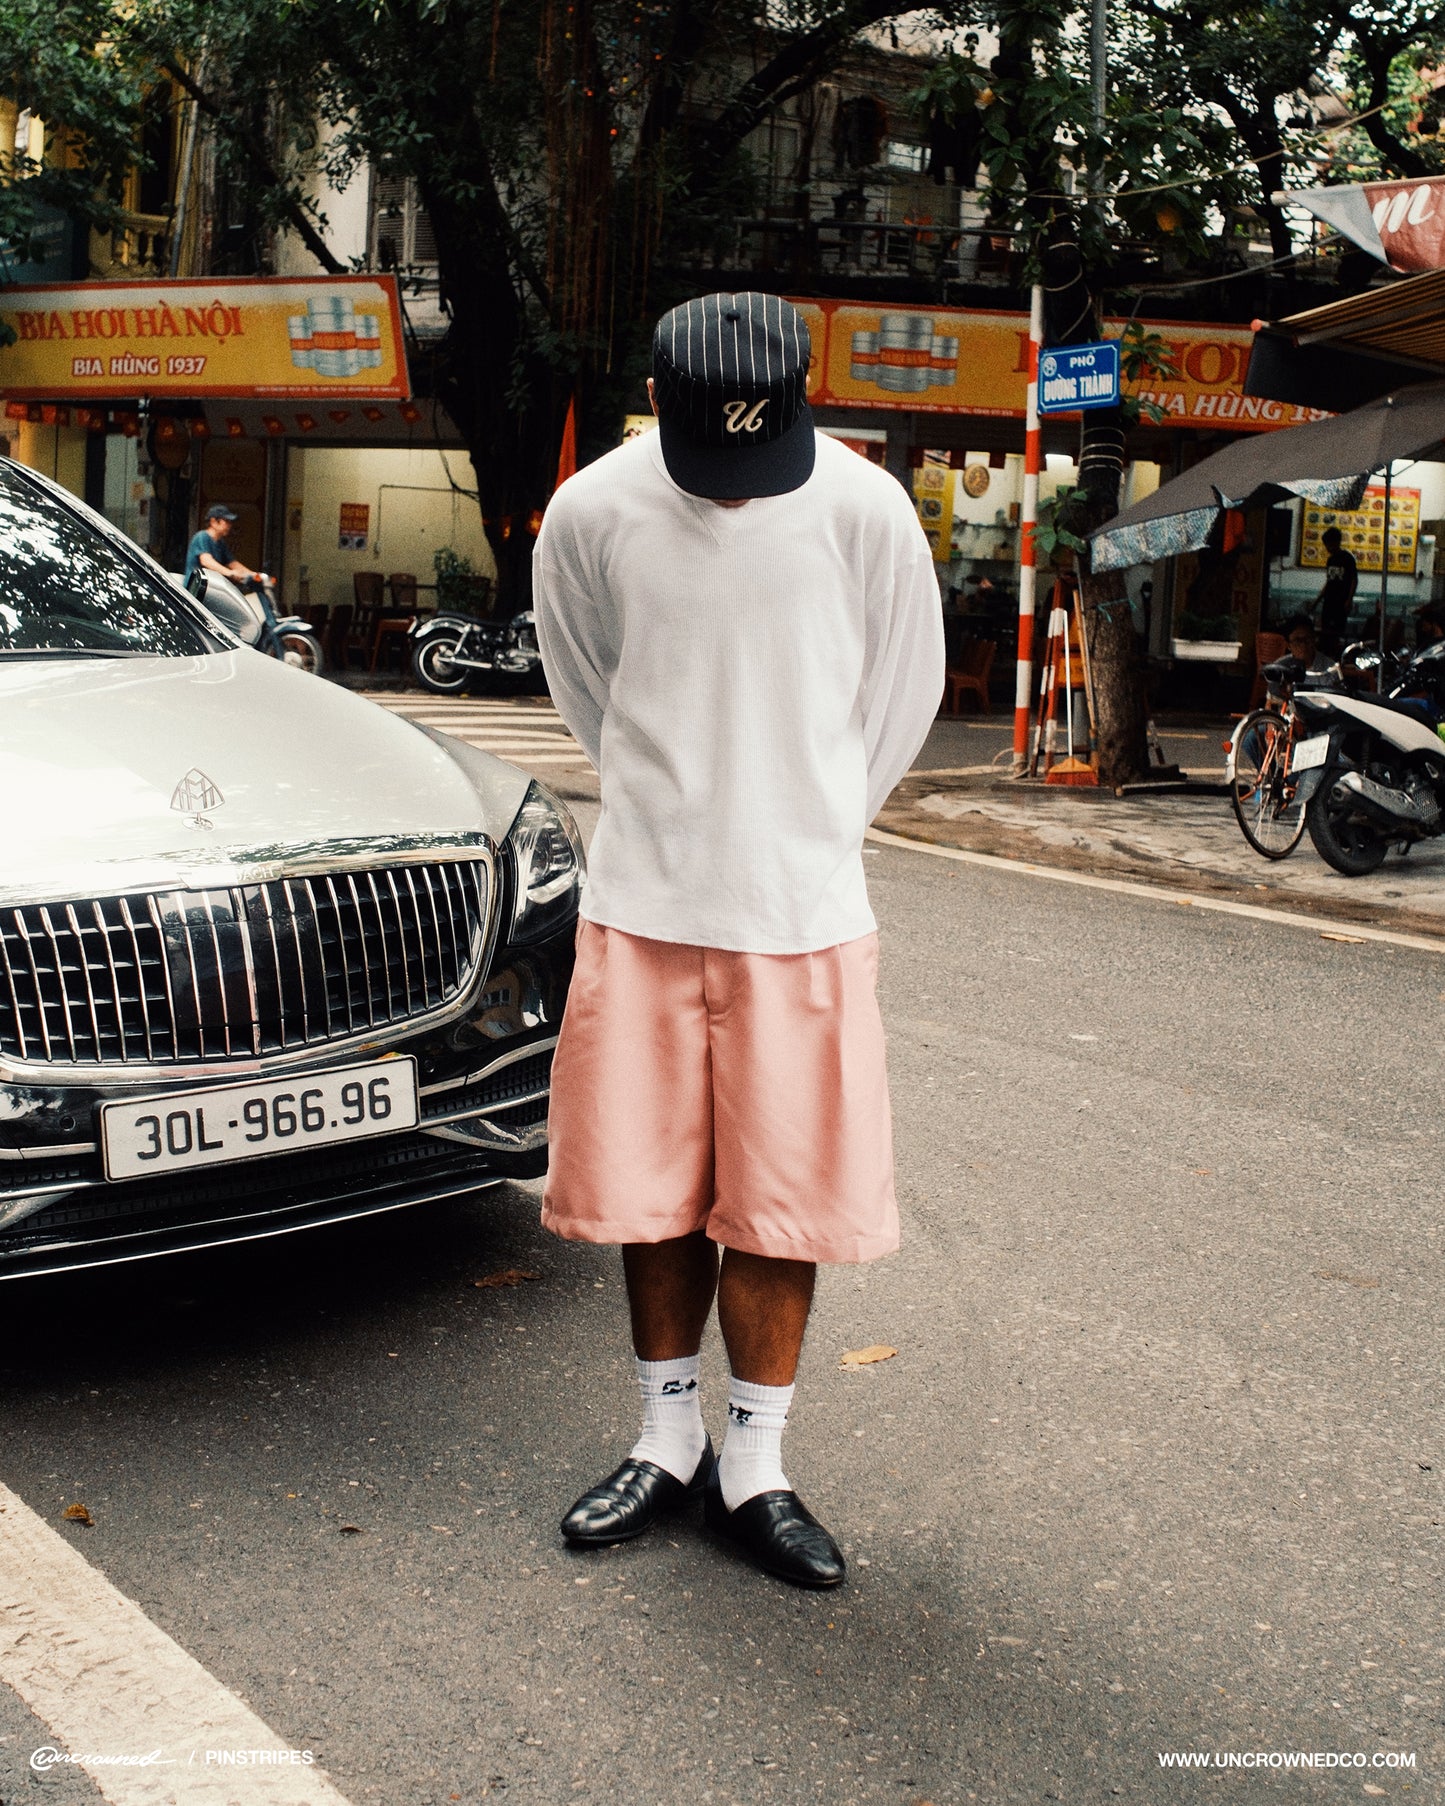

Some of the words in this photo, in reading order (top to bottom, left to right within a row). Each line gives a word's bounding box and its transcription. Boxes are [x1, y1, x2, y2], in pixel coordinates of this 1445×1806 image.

[15, 310, 68, 340] BIA
[131, 299, 181, 338] HÀ
[181, 299, 245, 345] NỘI
[73, 358, 102, 376] BIA
[110, 352, 159, 375] HÙNG
[167, 357, 206, 375] 1937
[1080, 370, 1113, 397] THÀNH
[1193, 389, 1282, 421] HÙNG
[135, 1077, 392, 1160] 30L-966.96
